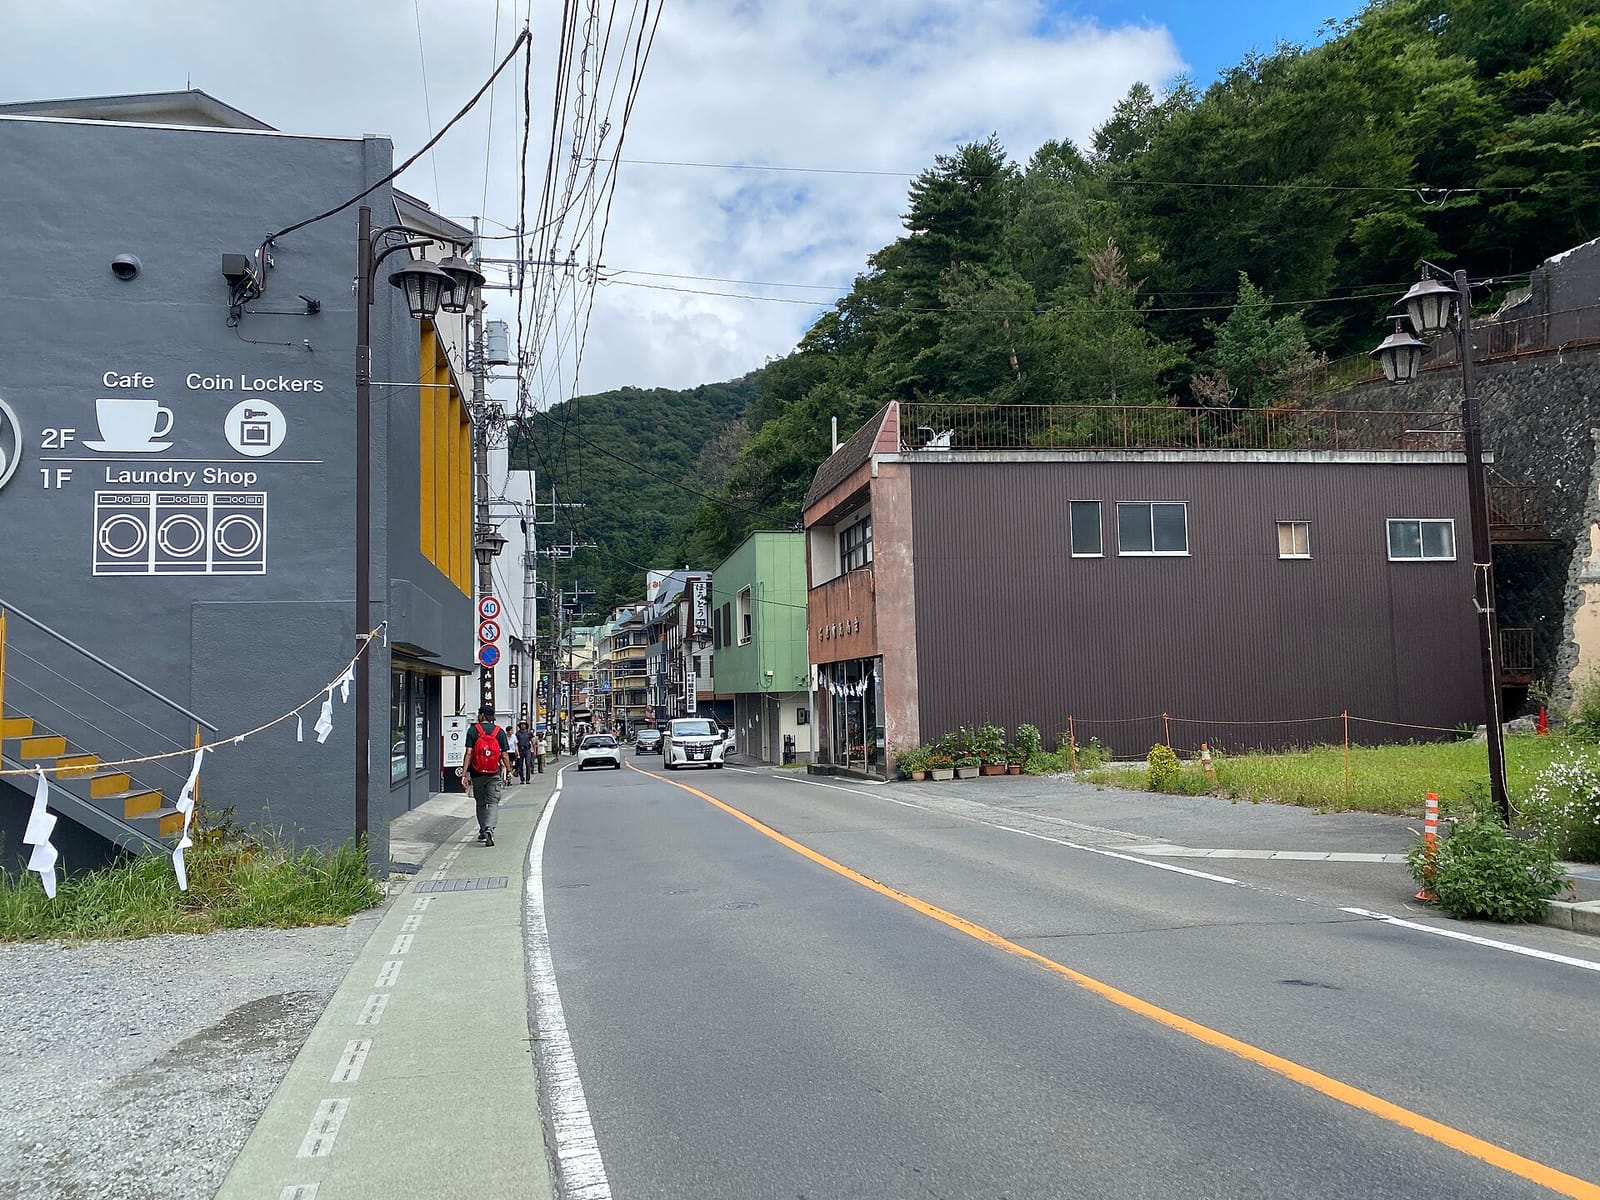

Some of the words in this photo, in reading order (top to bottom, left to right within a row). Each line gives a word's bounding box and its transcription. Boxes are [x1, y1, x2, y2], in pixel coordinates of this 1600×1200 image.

[103, 371, 155, 390] Cafe
[186, 373, 234, 391] Coin
[240, 374, 324, 393] Lockers
[40, 428, 76, 449] 2F
[40, 468, 73, 489] 1F
[105, 466, 196, 487] Laundry
[203, 467, 258, 488] Shop
[483, 602, 496, 614] 40
[695, 583, 705, 618] ほうとう
